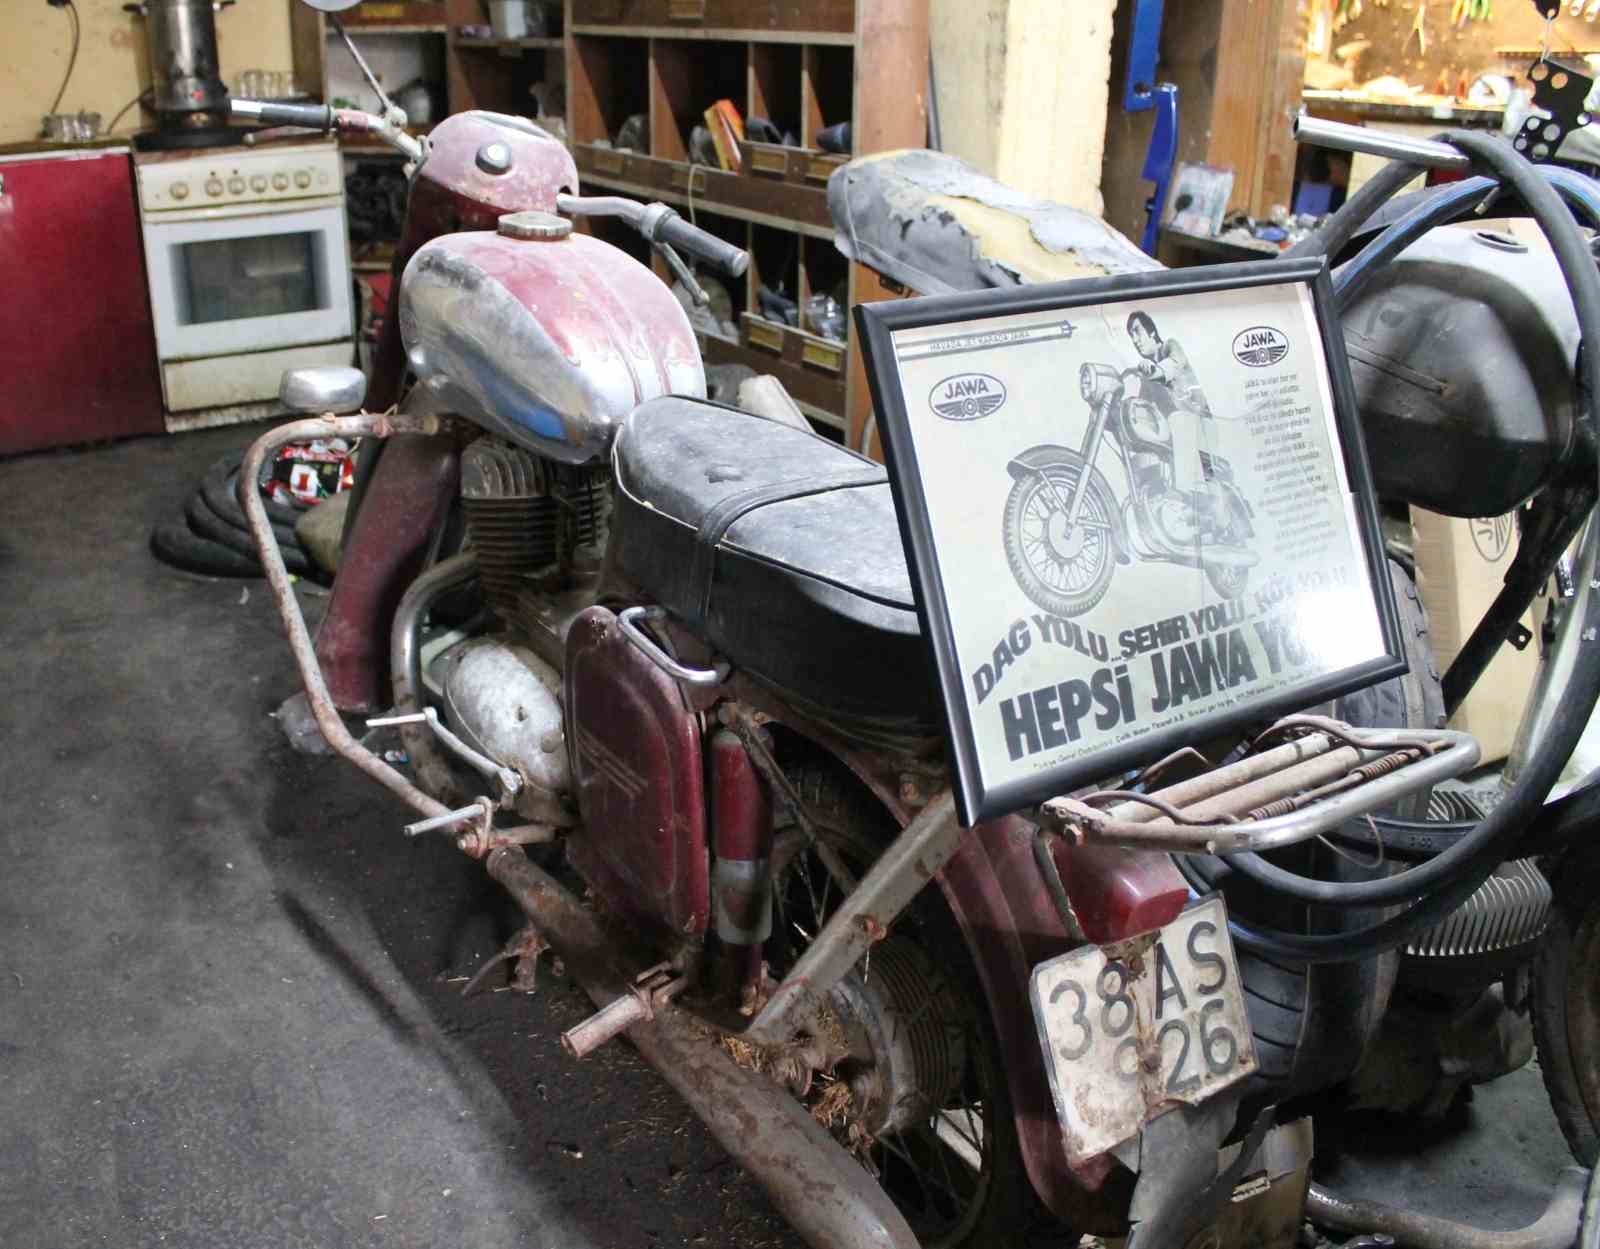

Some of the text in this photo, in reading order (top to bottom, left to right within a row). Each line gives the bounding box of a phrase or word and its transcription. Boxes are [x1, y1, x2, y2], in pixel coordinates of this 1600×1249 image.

[1244, 332, 1276, 348] JAWA
[945, 378, 989, 399] JAWA
[1150, 629, 1258, 713] JAWA
[1050, 920, 1228, 1061] 38 AS
